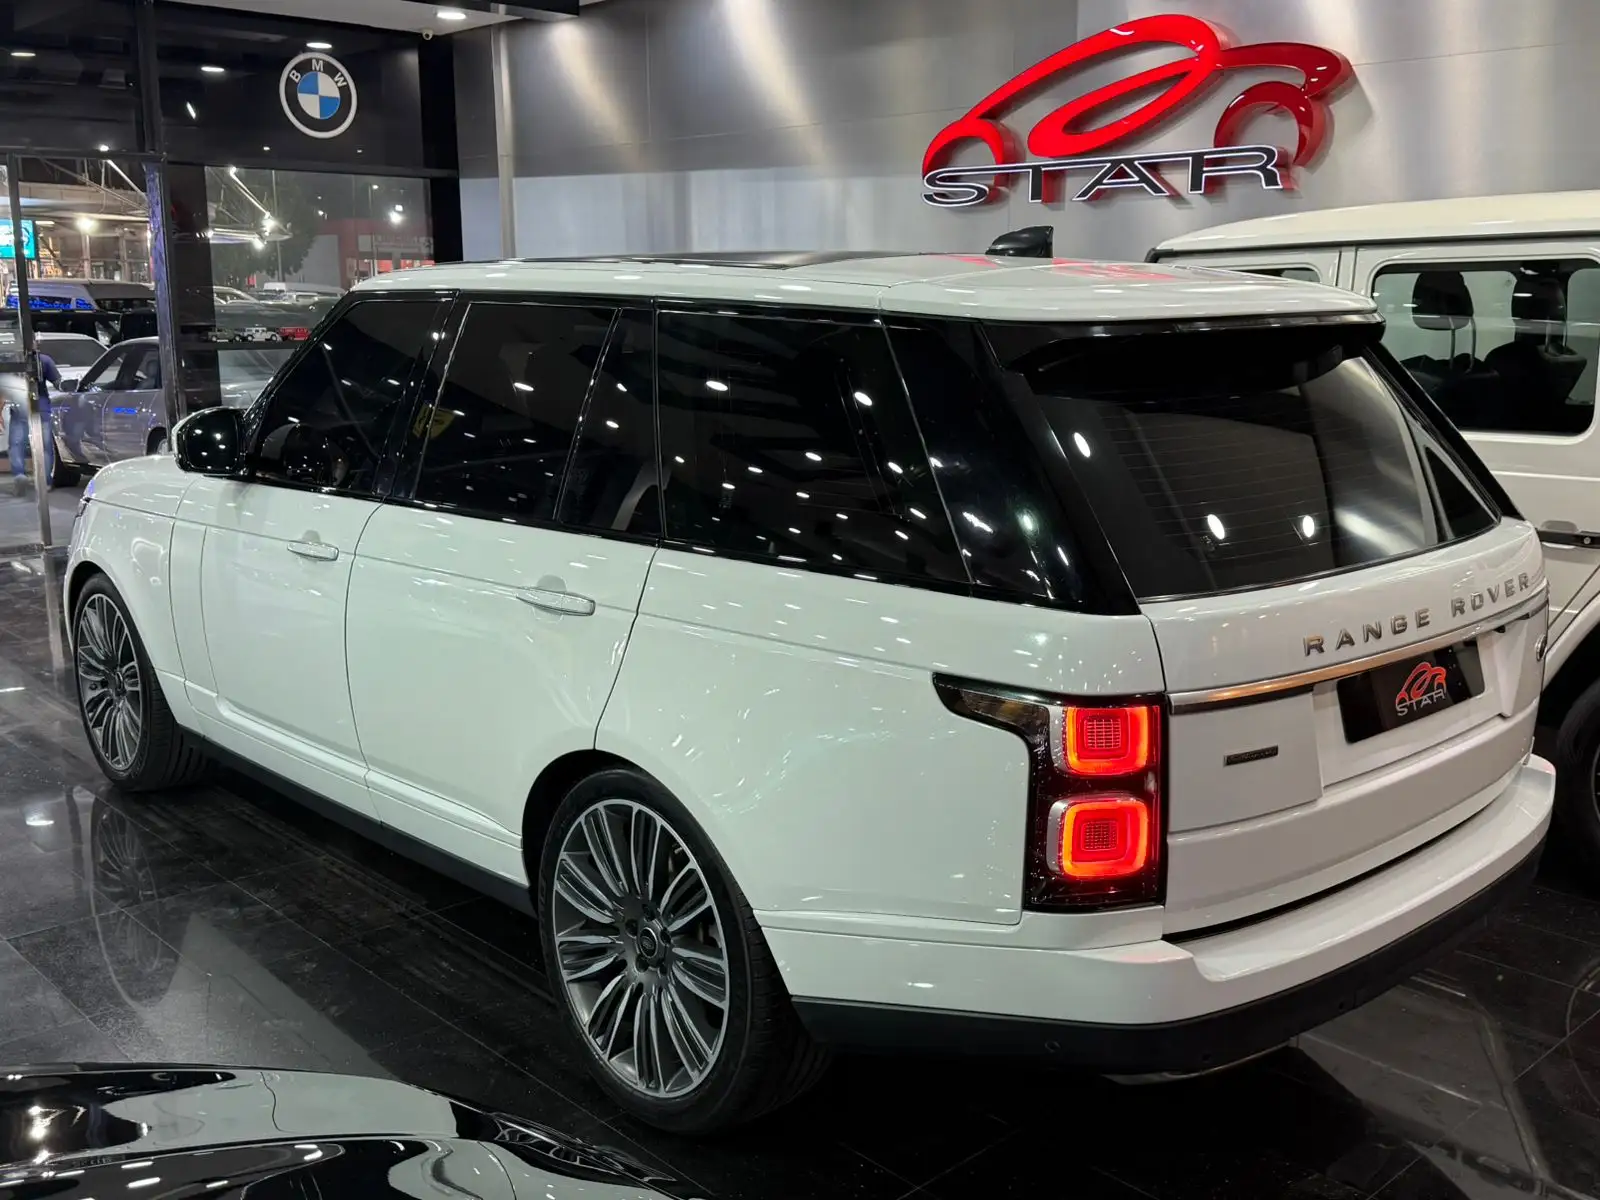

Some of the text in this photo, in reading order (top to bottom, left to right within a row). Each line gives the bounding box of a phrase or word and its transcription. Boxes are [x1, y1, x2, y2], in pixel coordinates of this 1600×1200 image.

[289, 58, 347, 88] BMW
[922, 145, 1283, 207] STAR
[1302, 571, 1530, 656] RANGE ROVER
[1396, 689, 1446, 717] STAR
